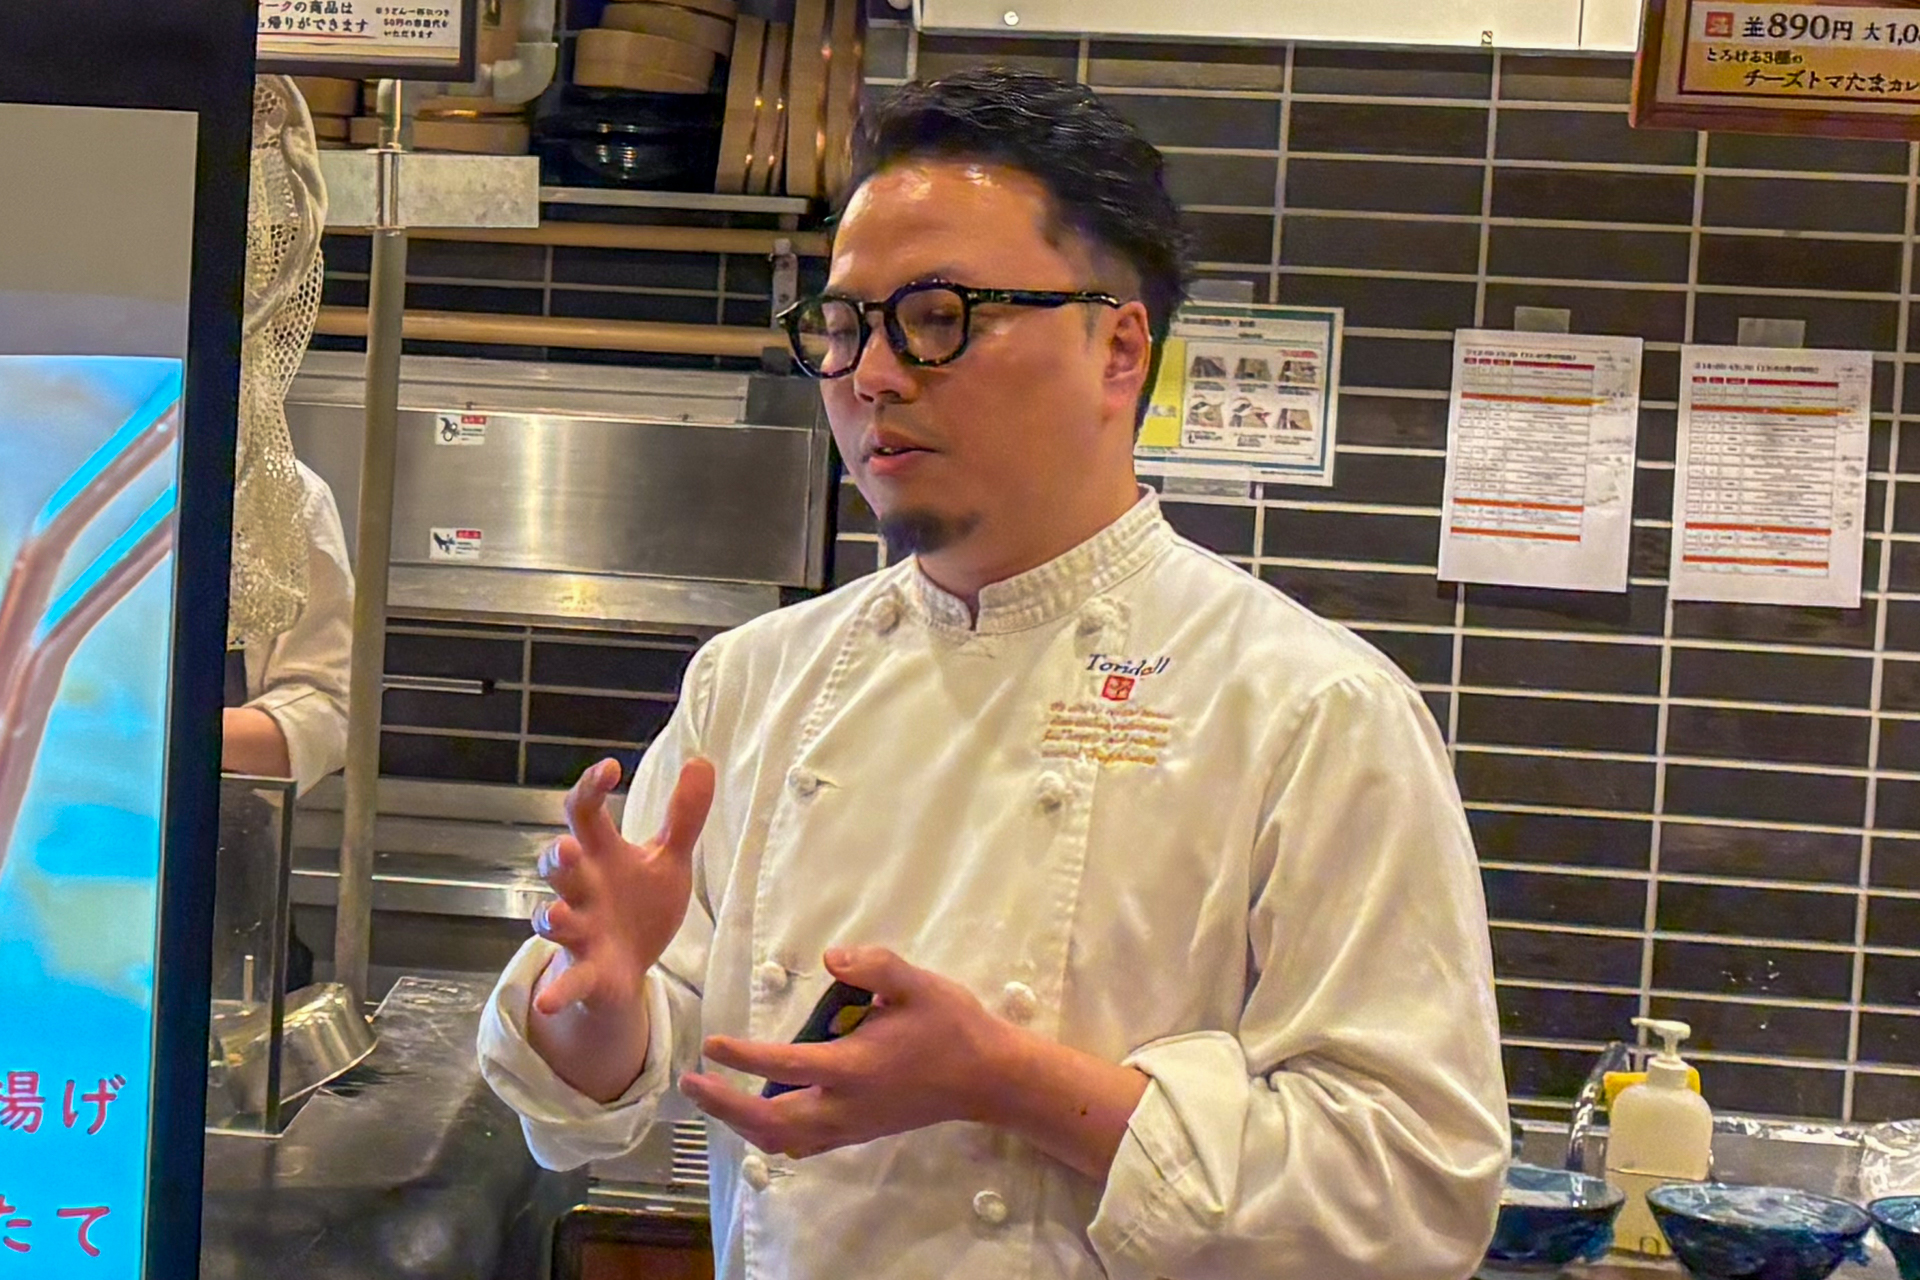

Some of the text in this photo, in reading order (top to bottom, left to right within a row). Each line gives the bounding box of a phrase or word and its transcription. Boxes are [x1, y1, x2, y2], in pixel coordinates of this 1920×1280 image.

[258, 0, 353, 14] ークの商品は
[1862, 22, 1920, 46] 大1,0
[1086, 653, 1171, 677] Toridoll
